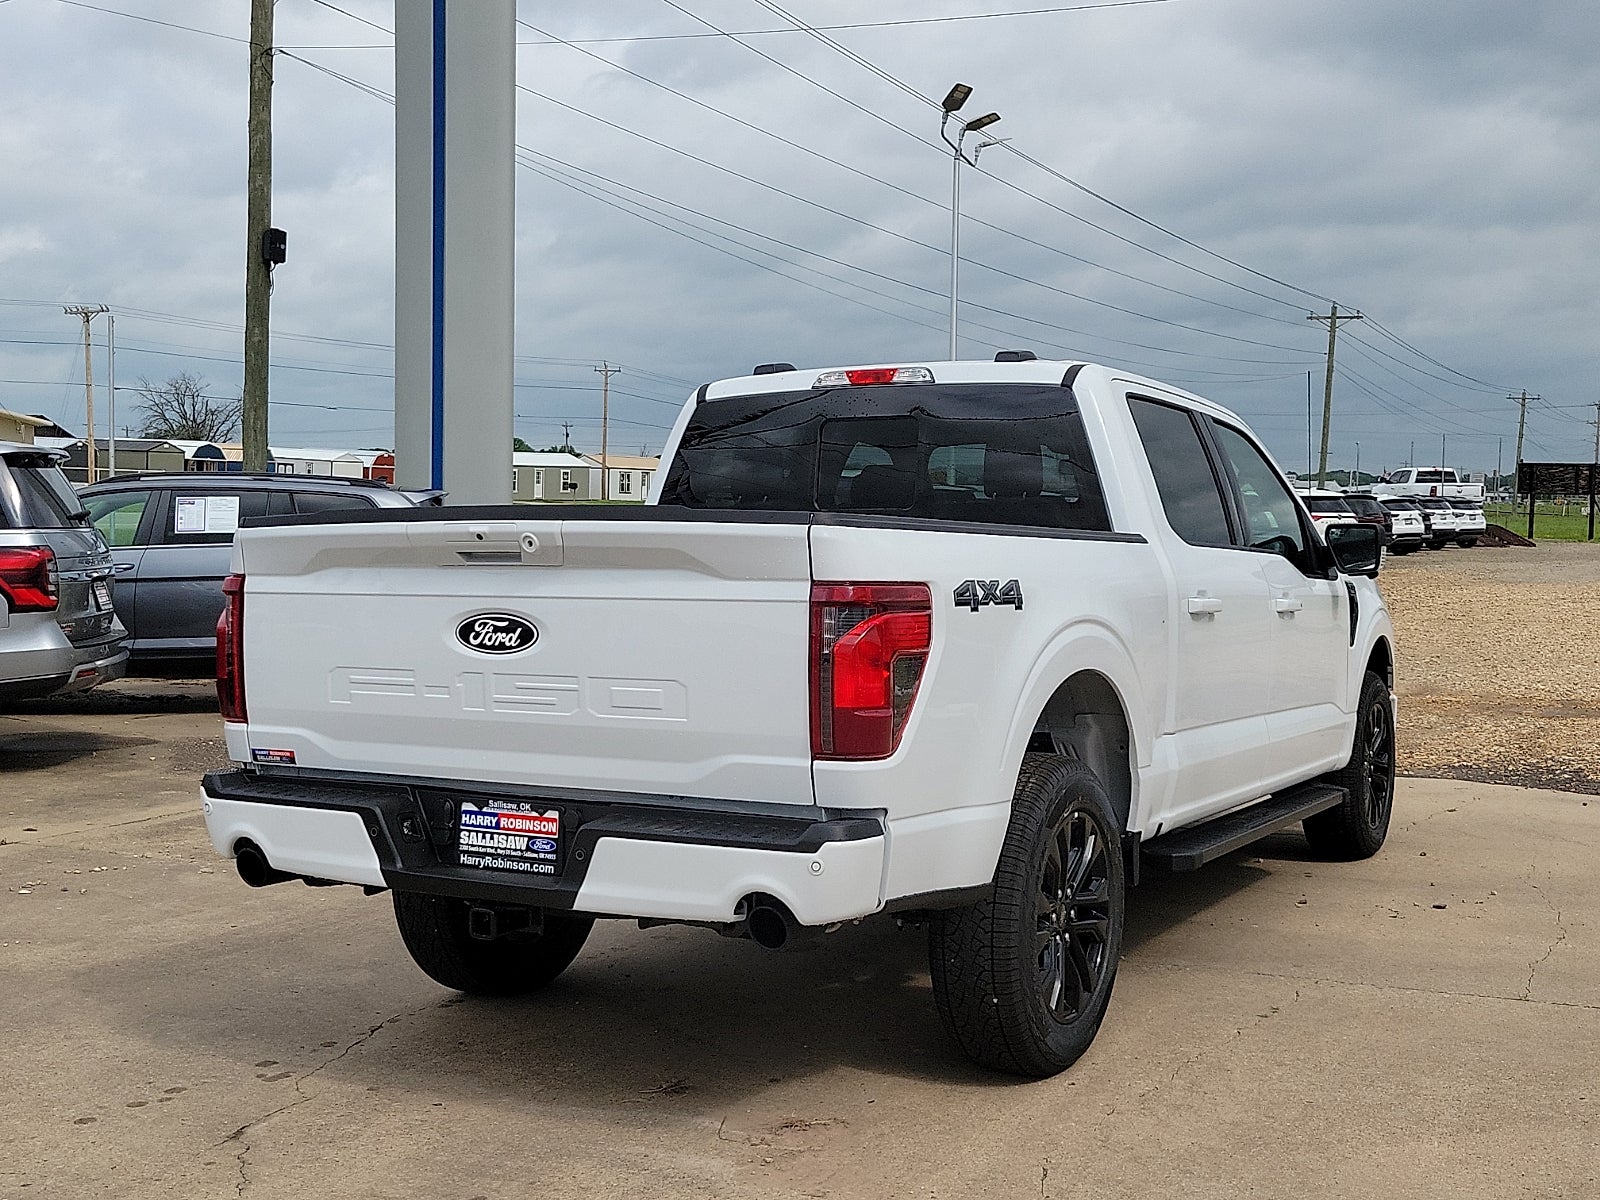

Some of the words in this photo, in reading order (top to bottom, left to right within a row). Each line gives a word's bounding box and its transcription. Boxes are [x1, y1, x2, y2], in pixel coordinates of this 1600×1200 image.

[469, 619, 523, 647] Ford
[329, 665, 688, 721] F-150
[488, 800, 519, 811] Sallisaw,
[520, 803, 532, 811] OK
[461, 813, 498, 827] HARRY
[500, 817, 557, 833] ROBINSON
[460, 831, 528, 851] SALLISAW
[460, 854, 554, 874] HarryRobinson.com
